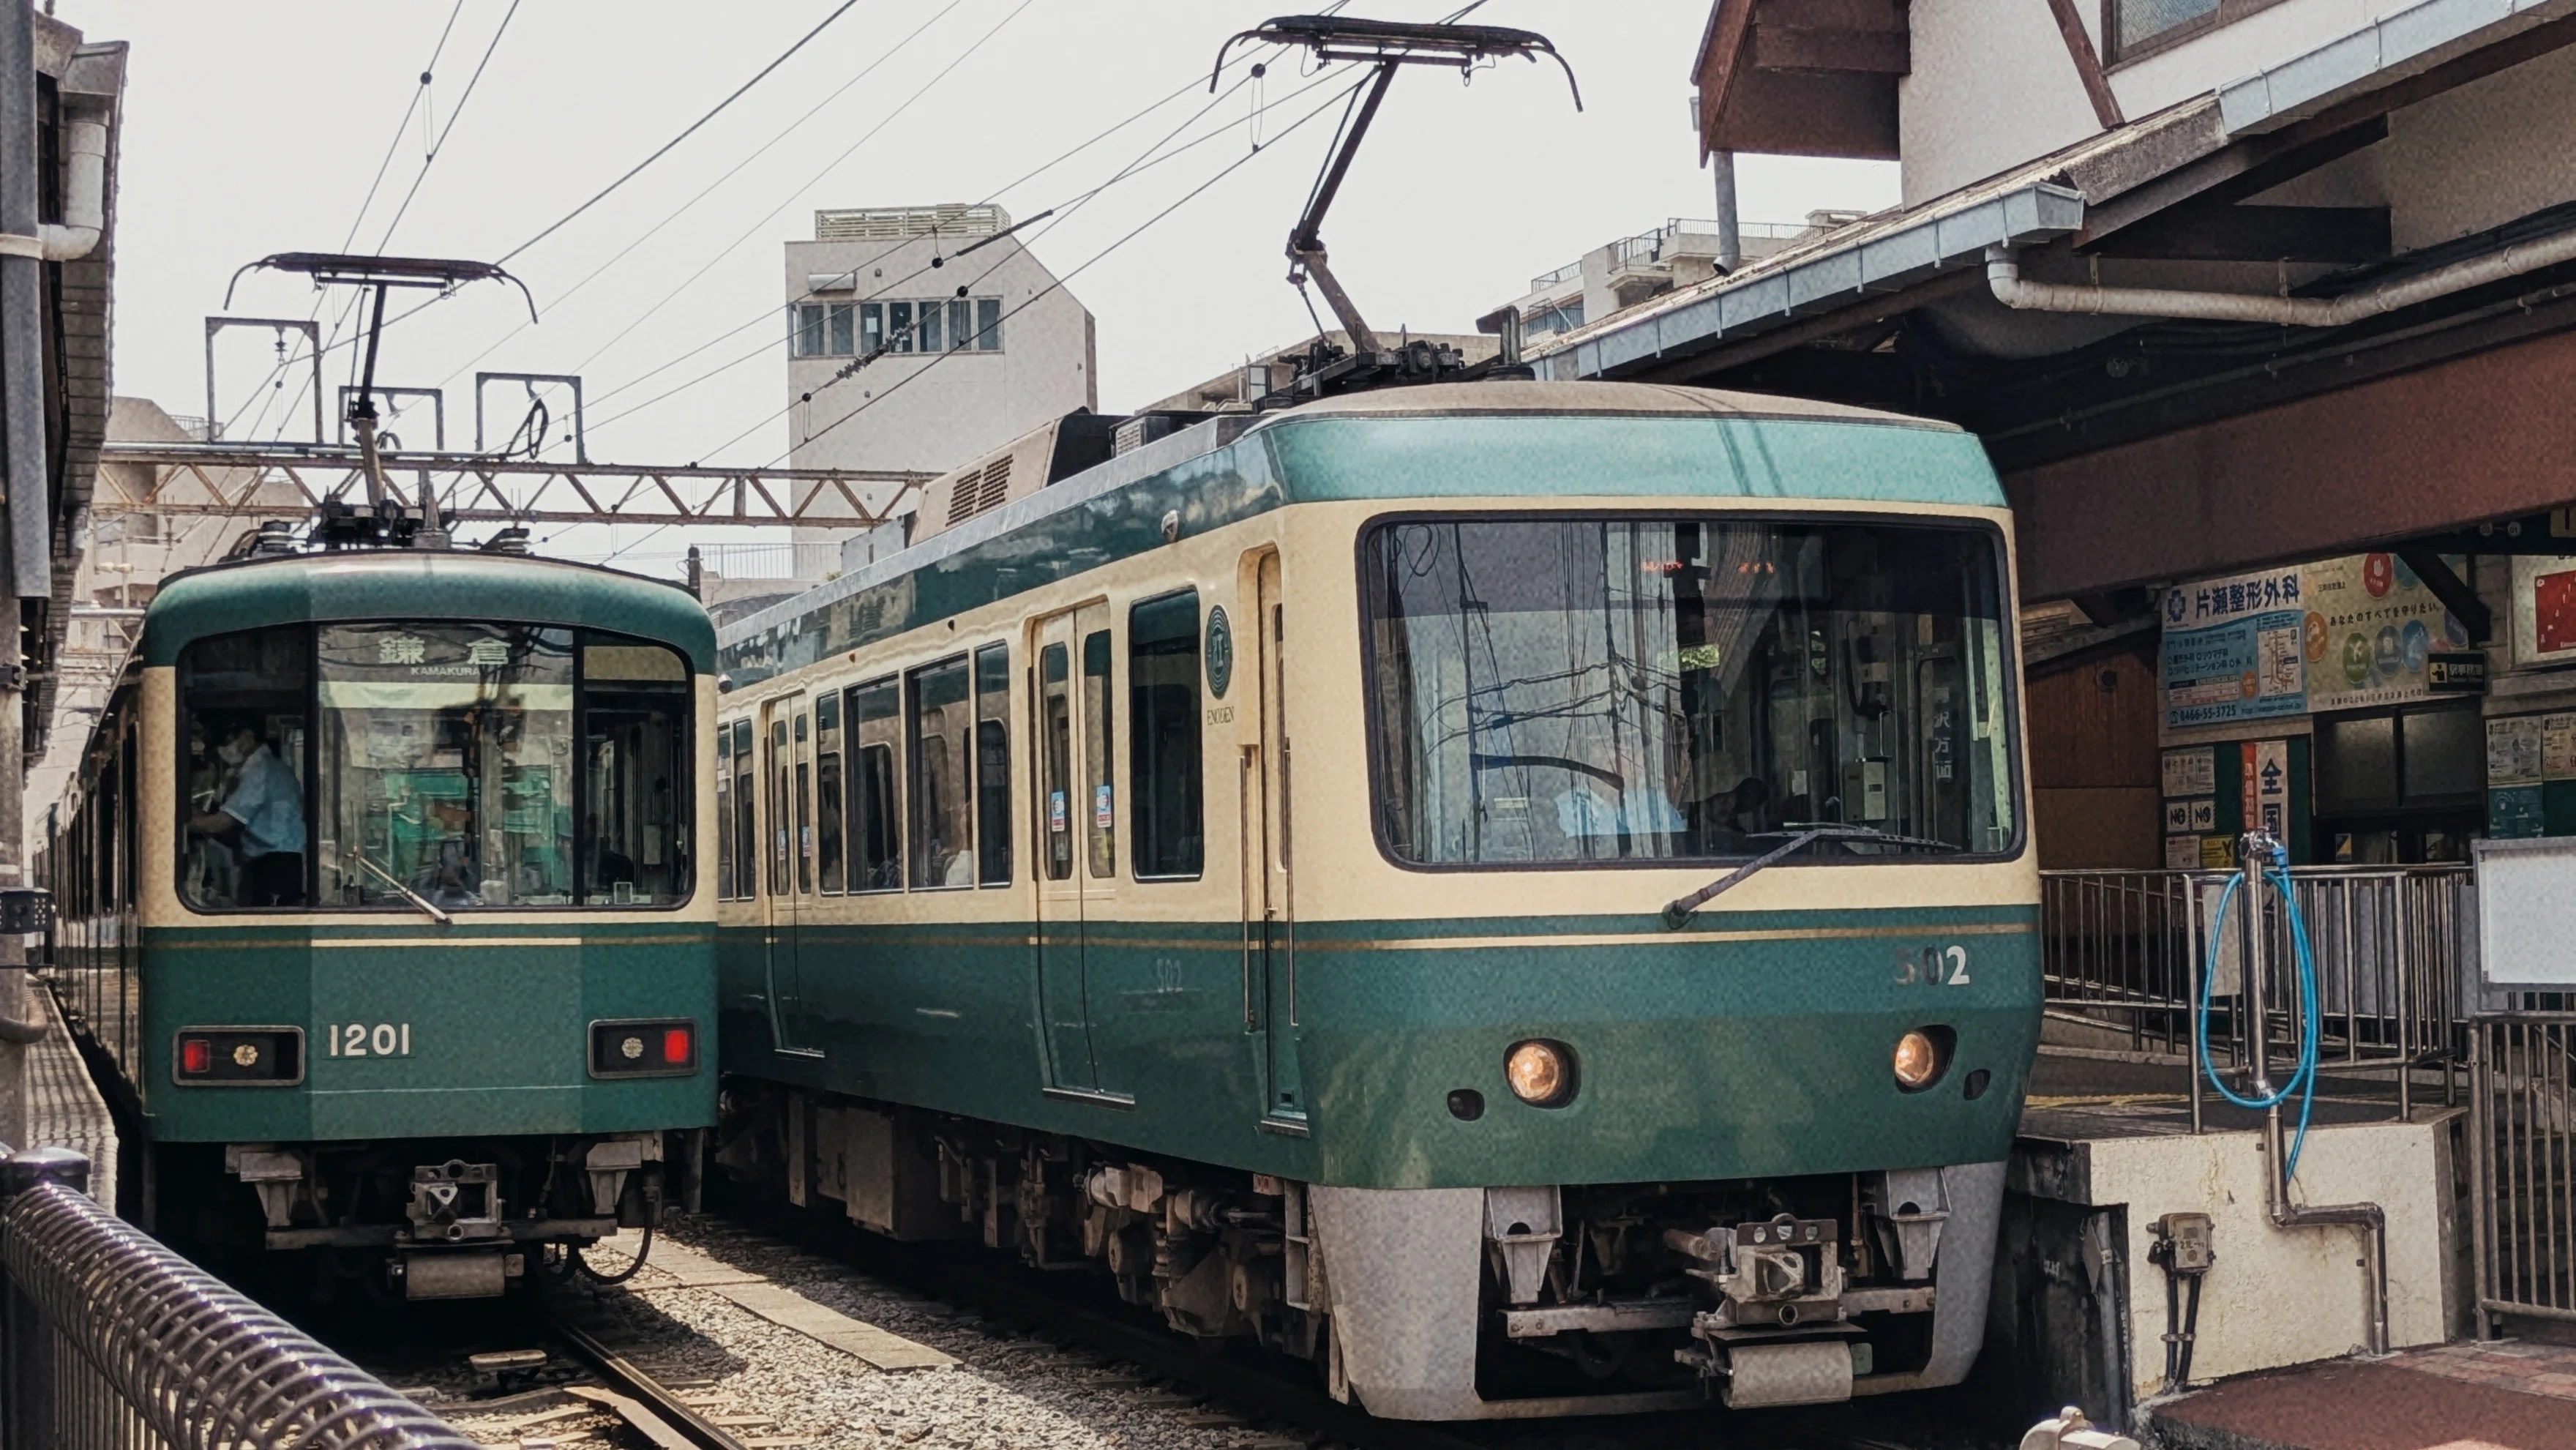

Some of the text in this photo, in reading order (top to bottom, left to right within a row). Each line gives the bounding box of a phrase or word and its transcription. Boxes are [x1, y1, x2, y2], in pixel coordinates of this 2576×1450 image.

[2196, 574, 2299, 619] 片瀬整形外科
[378, 636, 512, 665] 鎌倉
[411, 667, 480, 676] KAMAKURA
[1208, 706, 1235, 725] ENODEN
[1893, 945, 1970, 985] 502
[330, 1023, 410, 1056] 1201
